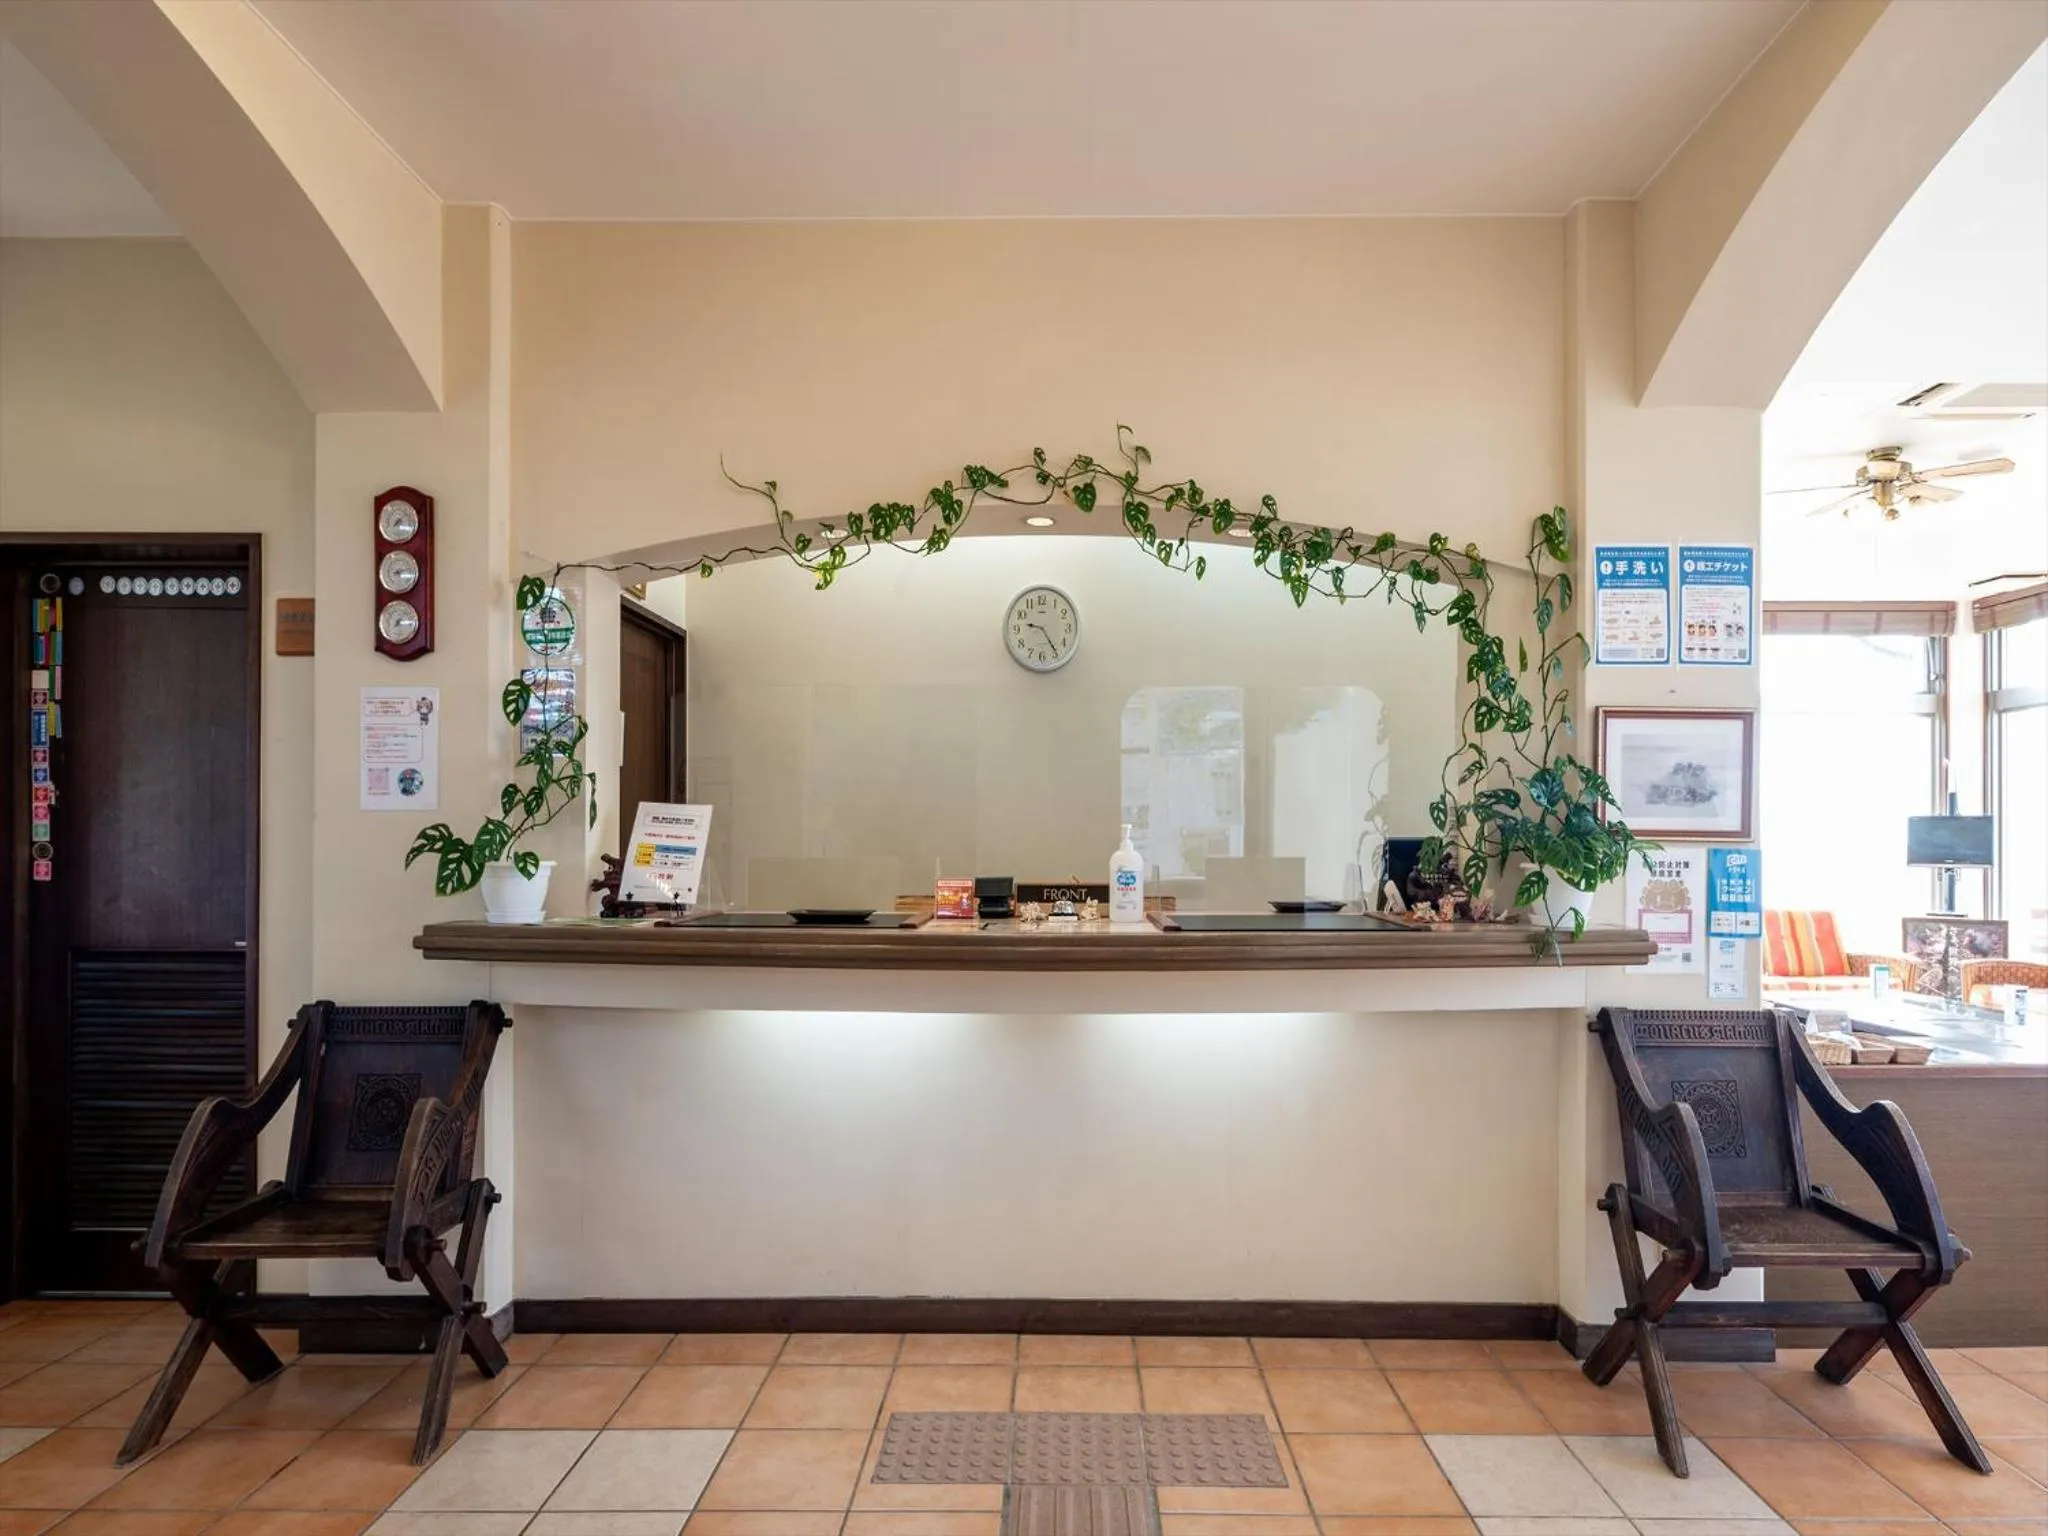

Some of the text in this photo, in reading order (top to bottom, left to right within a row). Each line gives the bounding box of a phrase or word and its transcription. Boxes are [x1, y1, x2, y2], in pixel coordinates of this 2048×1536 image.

[1615, 560, 1664, 576] 手洗い
[1043, 888, 1088, 901] FRONT
